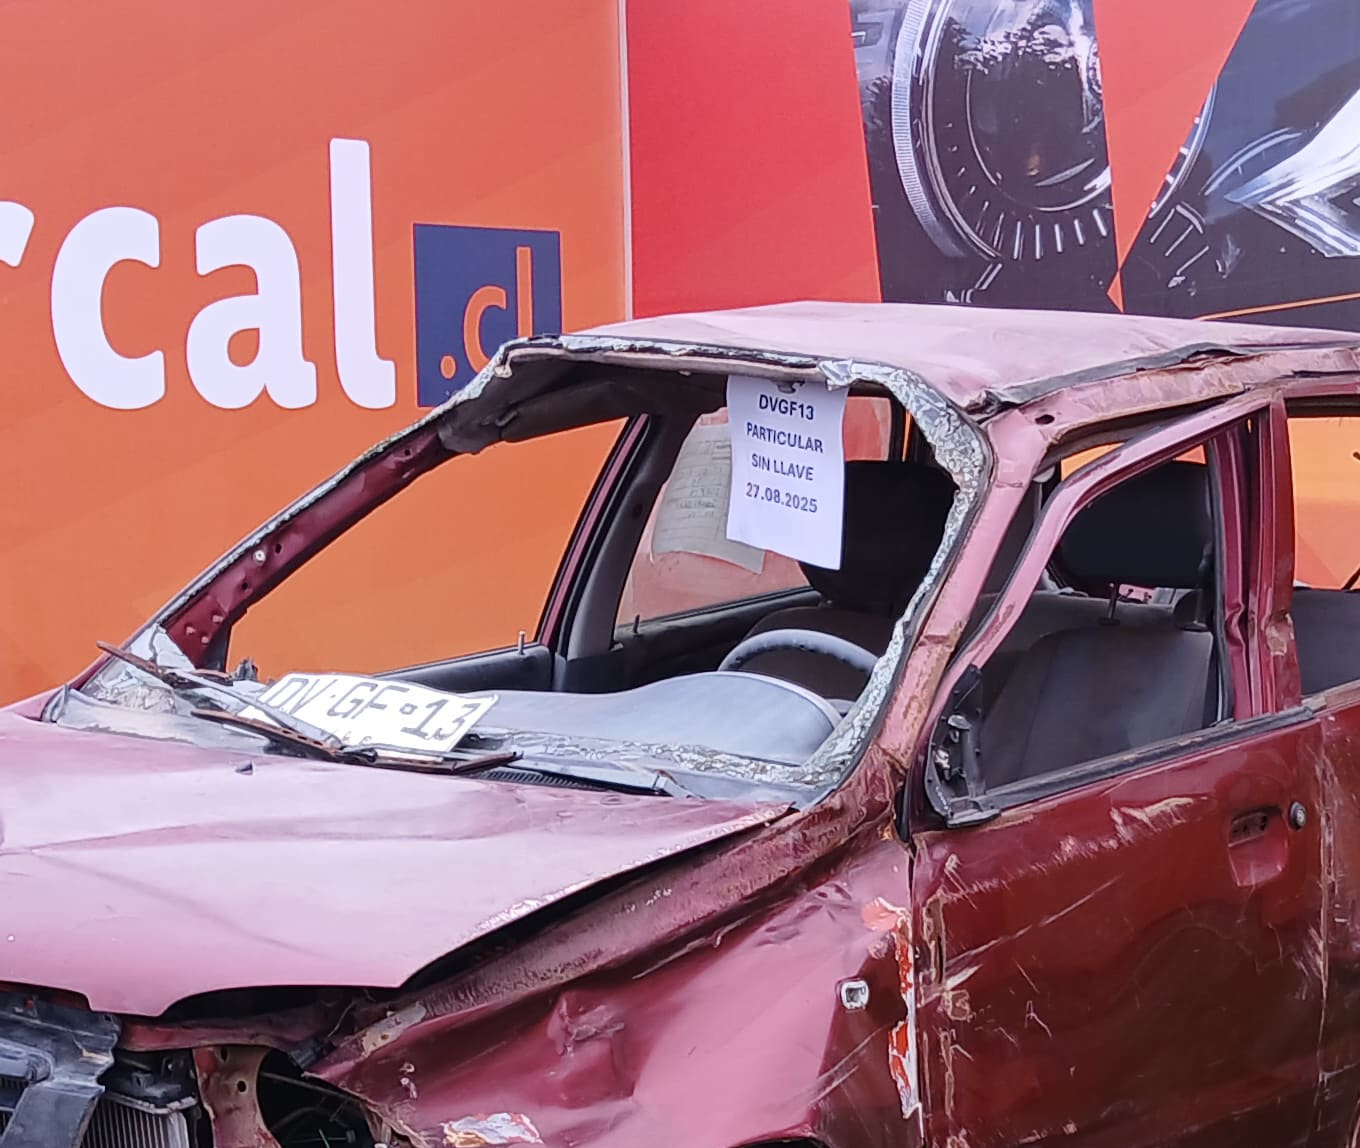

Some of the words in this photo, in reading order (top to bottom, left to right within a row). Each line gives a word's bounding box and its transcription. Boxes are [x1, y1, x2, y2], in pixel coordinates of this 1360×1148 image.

[759, 394, 815, 421] DVGF13
[746, 421, 824, 453] PARTICULAR
[751, 453, 771, 471] SIN
[773, 459, 814, 481] LLAVE
[745, 482, 819, 513] 27.08.2025
